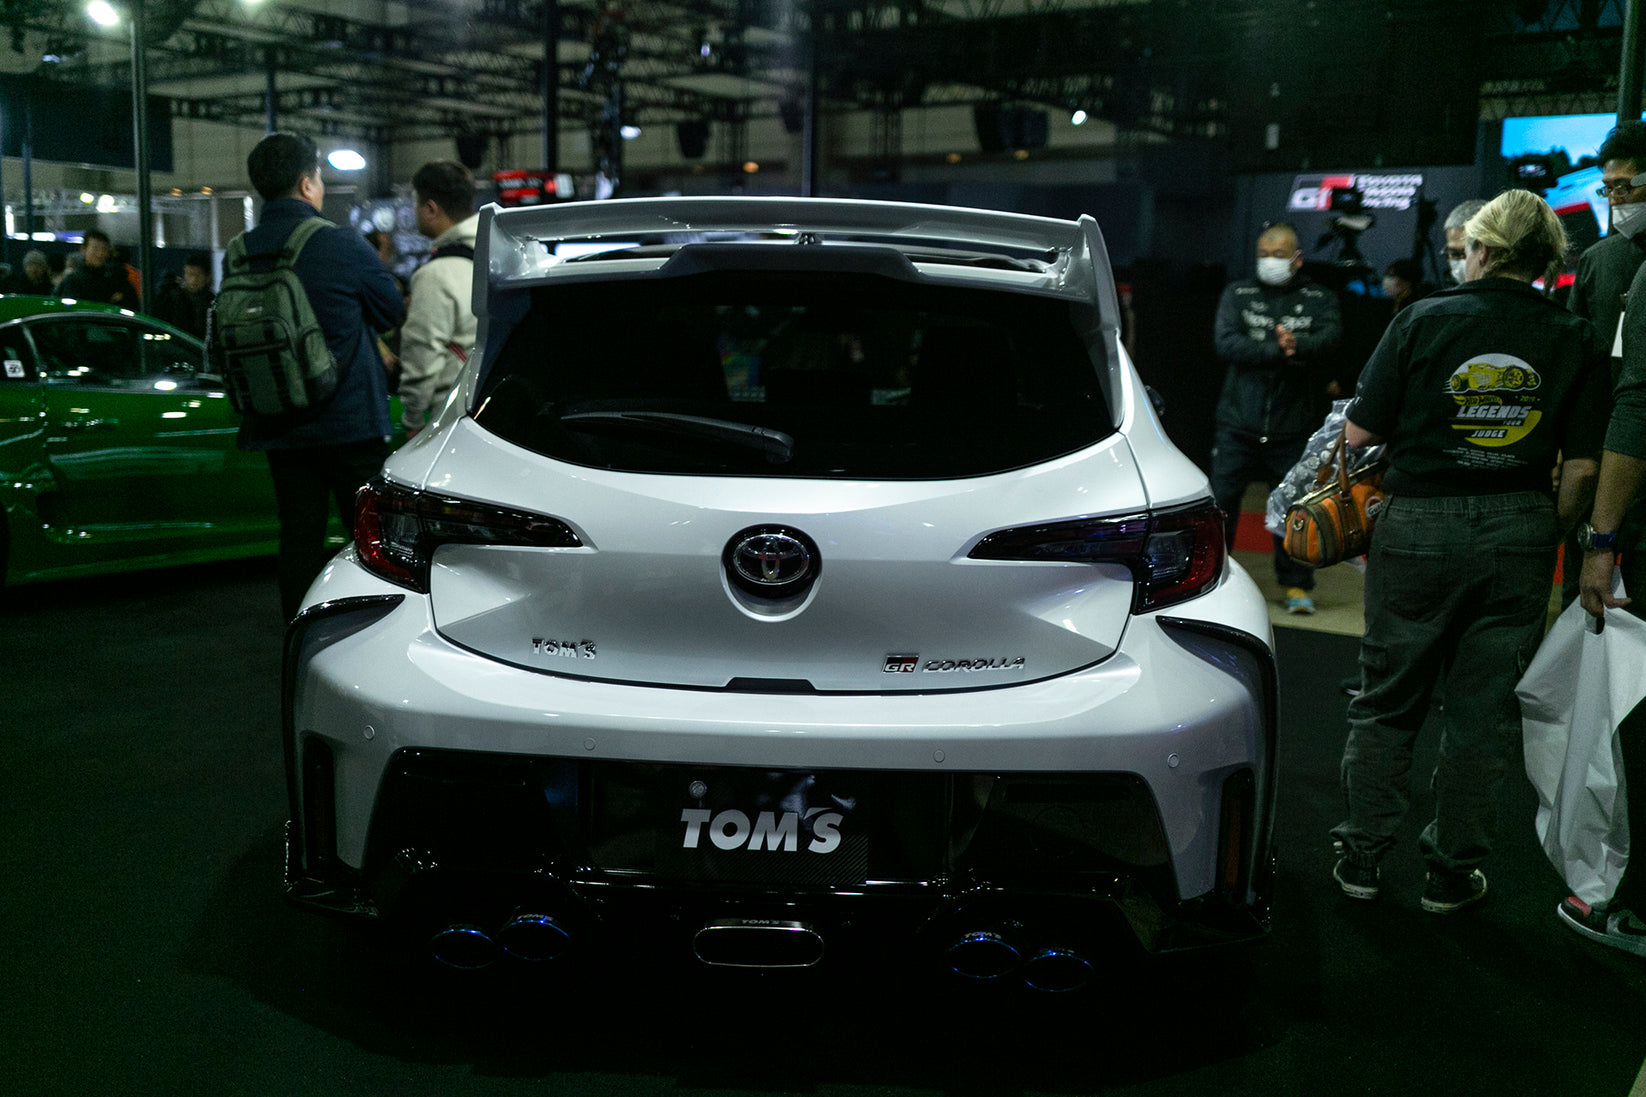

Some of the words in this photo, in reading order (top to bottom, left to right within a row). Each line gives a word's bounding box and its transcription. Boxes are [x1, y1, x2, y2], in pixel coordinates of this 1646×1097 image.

[1456, 405, 1532, 418] LEGENDS
[1471, 429, 1507, 438] JUDGE
[532, 638, 596, 660] TOM'S
[922, 657, 1026, 673] COROLLA
[680, 806, 845, 854] TOM'S
